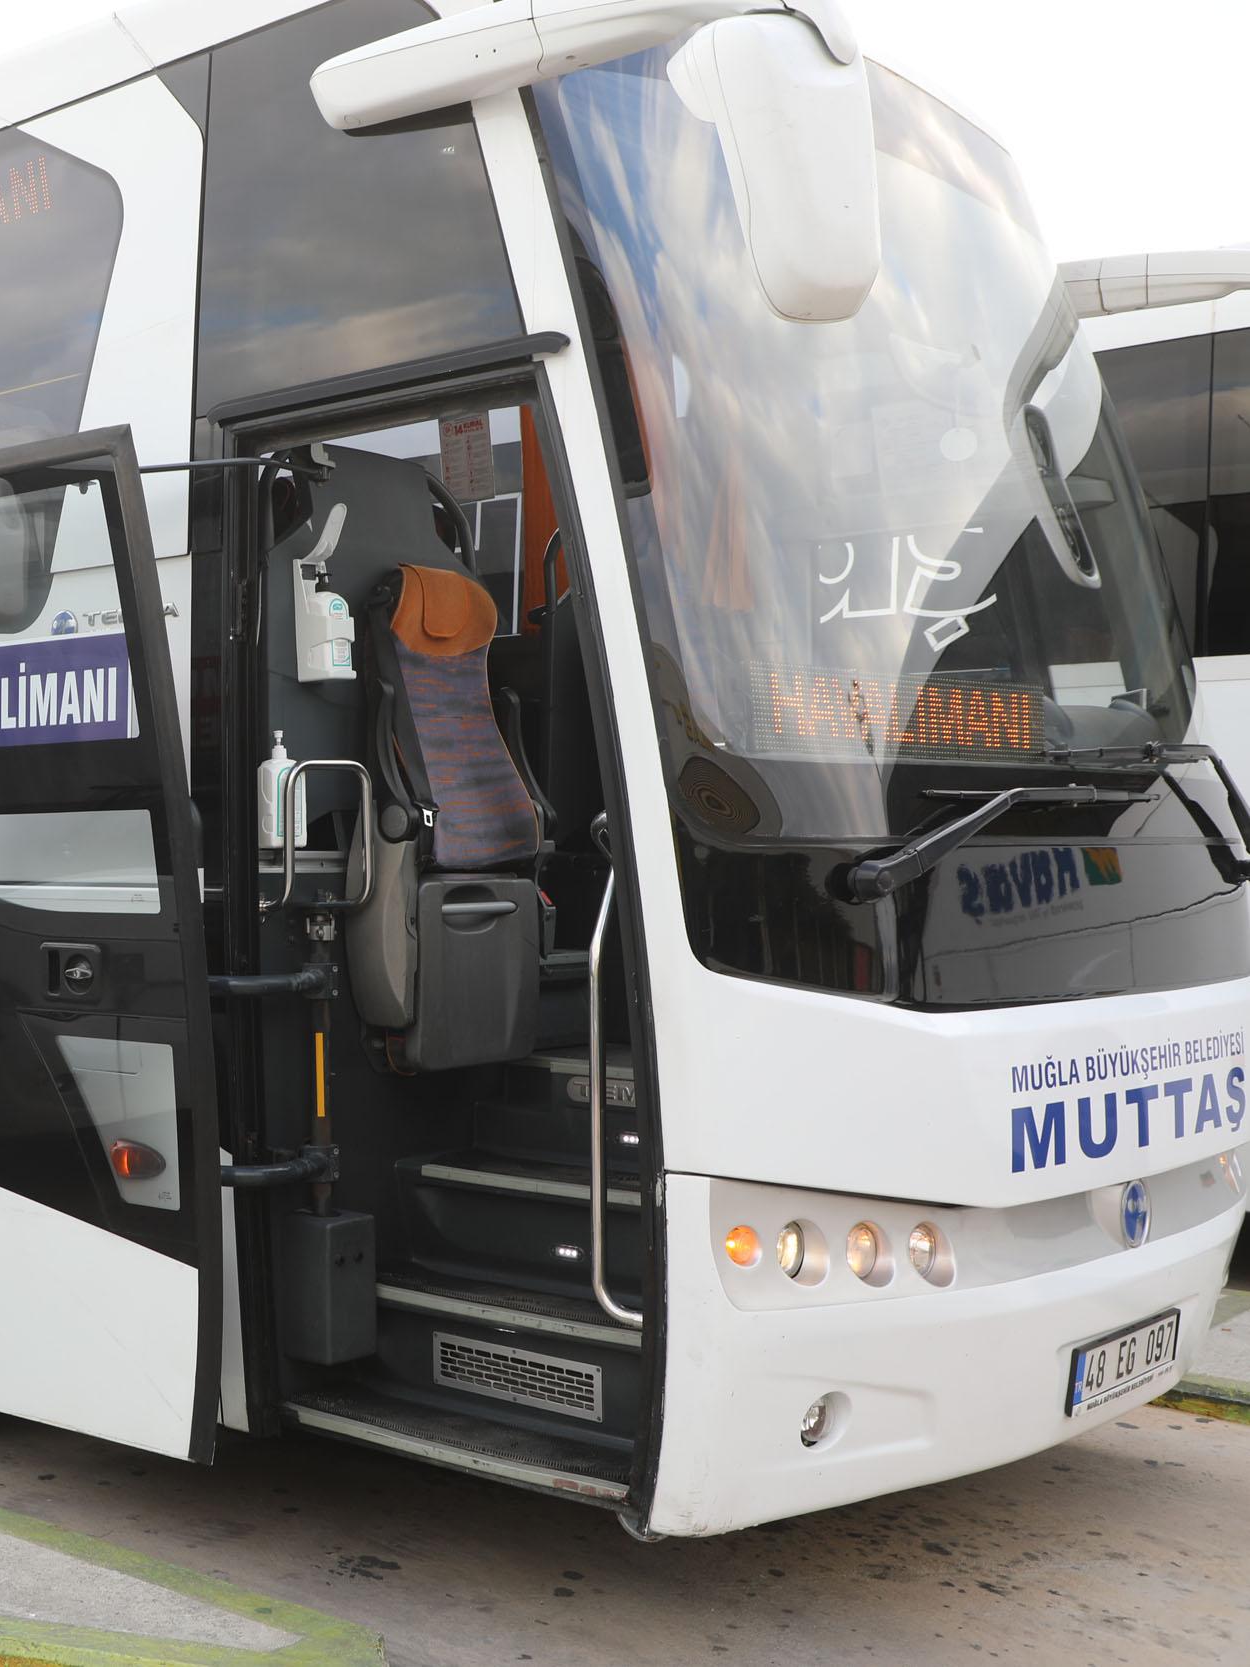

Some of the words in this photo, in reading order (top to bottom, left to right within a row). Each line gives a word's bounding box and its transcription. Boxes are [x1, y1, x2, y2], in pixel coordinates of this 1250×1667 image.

[1011, 1055, 1080, 1093] MUĞLA
[1085, 1038, 1182, 1082] BÜYÜKŞEHİR
[1185, 1026, 1245, 1065] BELEDİYESİ
[1011, 1066, 1246, 1174] MUTTAŞ
[1085, 1350, 1106, 1391] 48
[1116, 1337, 1137, 1379] EG
[1146, 1321, 1174, 1365] 097
